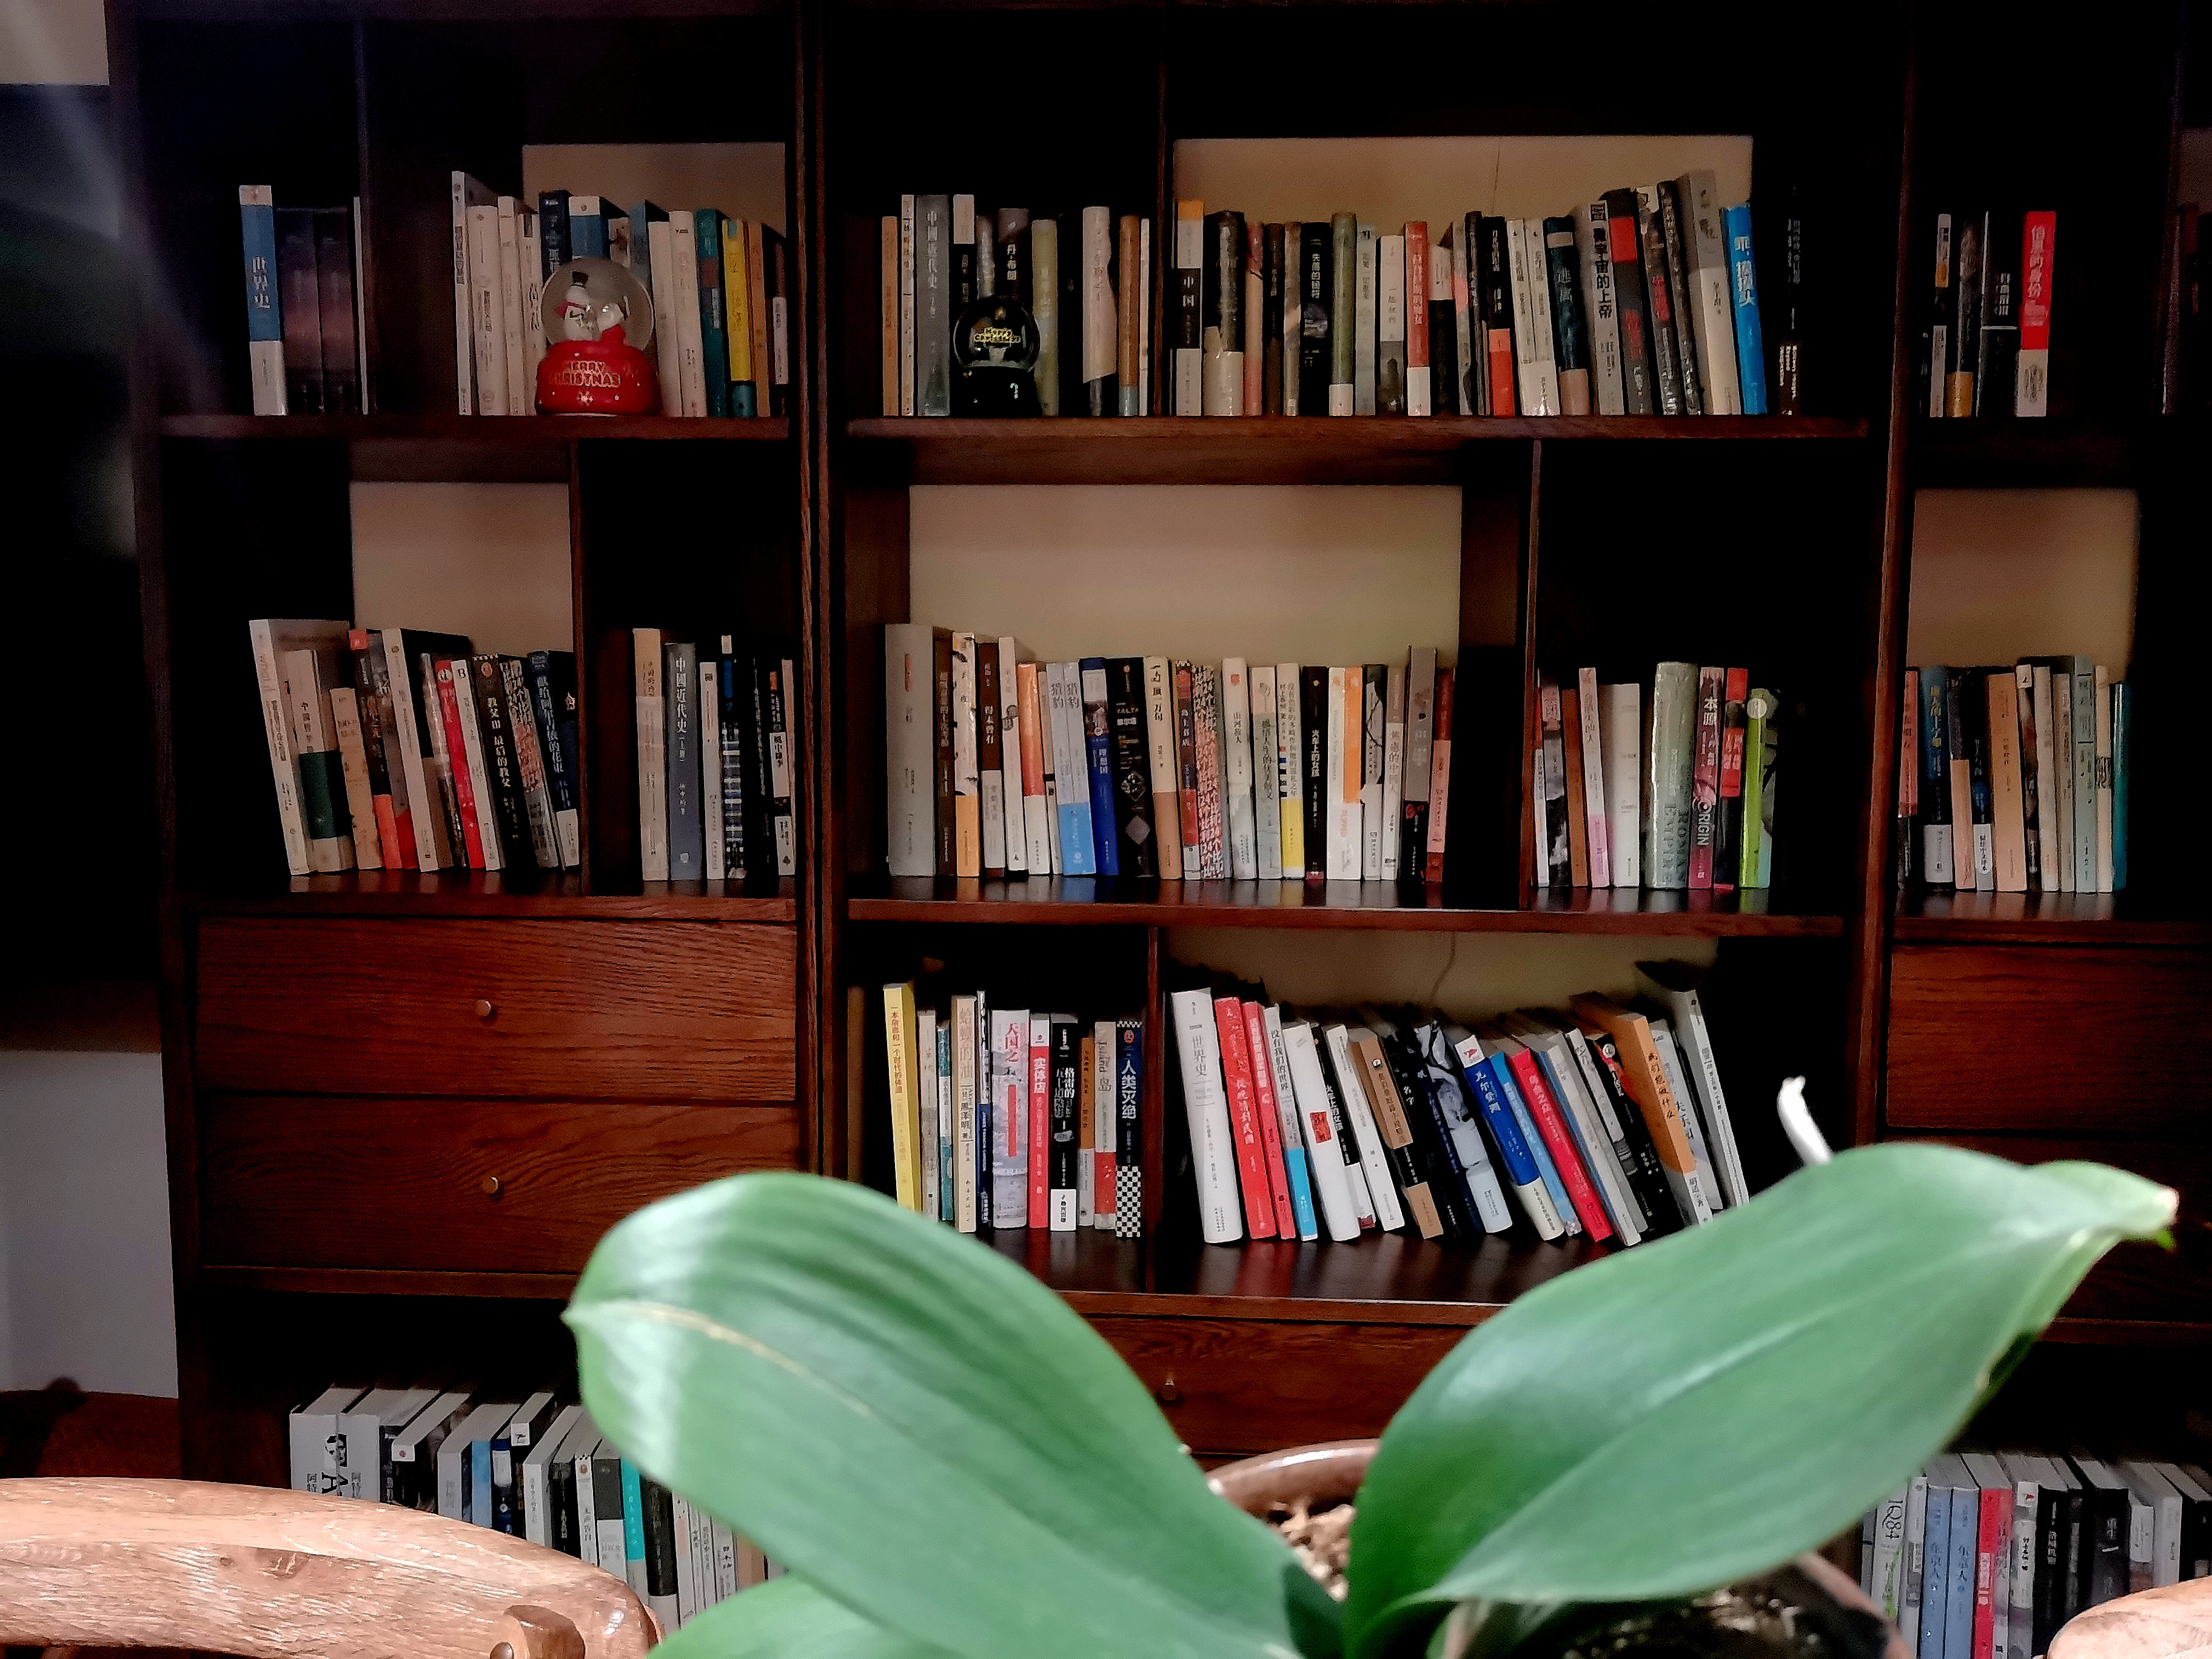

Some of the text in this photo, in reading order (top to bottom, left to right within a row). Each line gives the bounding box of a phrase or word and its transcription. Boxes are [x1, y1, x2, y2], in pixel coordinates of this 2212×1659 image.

[1311, 729, 1320, 777] 火车上的女孩
[1697, 800, 1714, 846] ORIGIN
[1121, 1059, 1136, 1119] 人类灭绝
[1883, 1500, 1903, 1540] 1Q84
